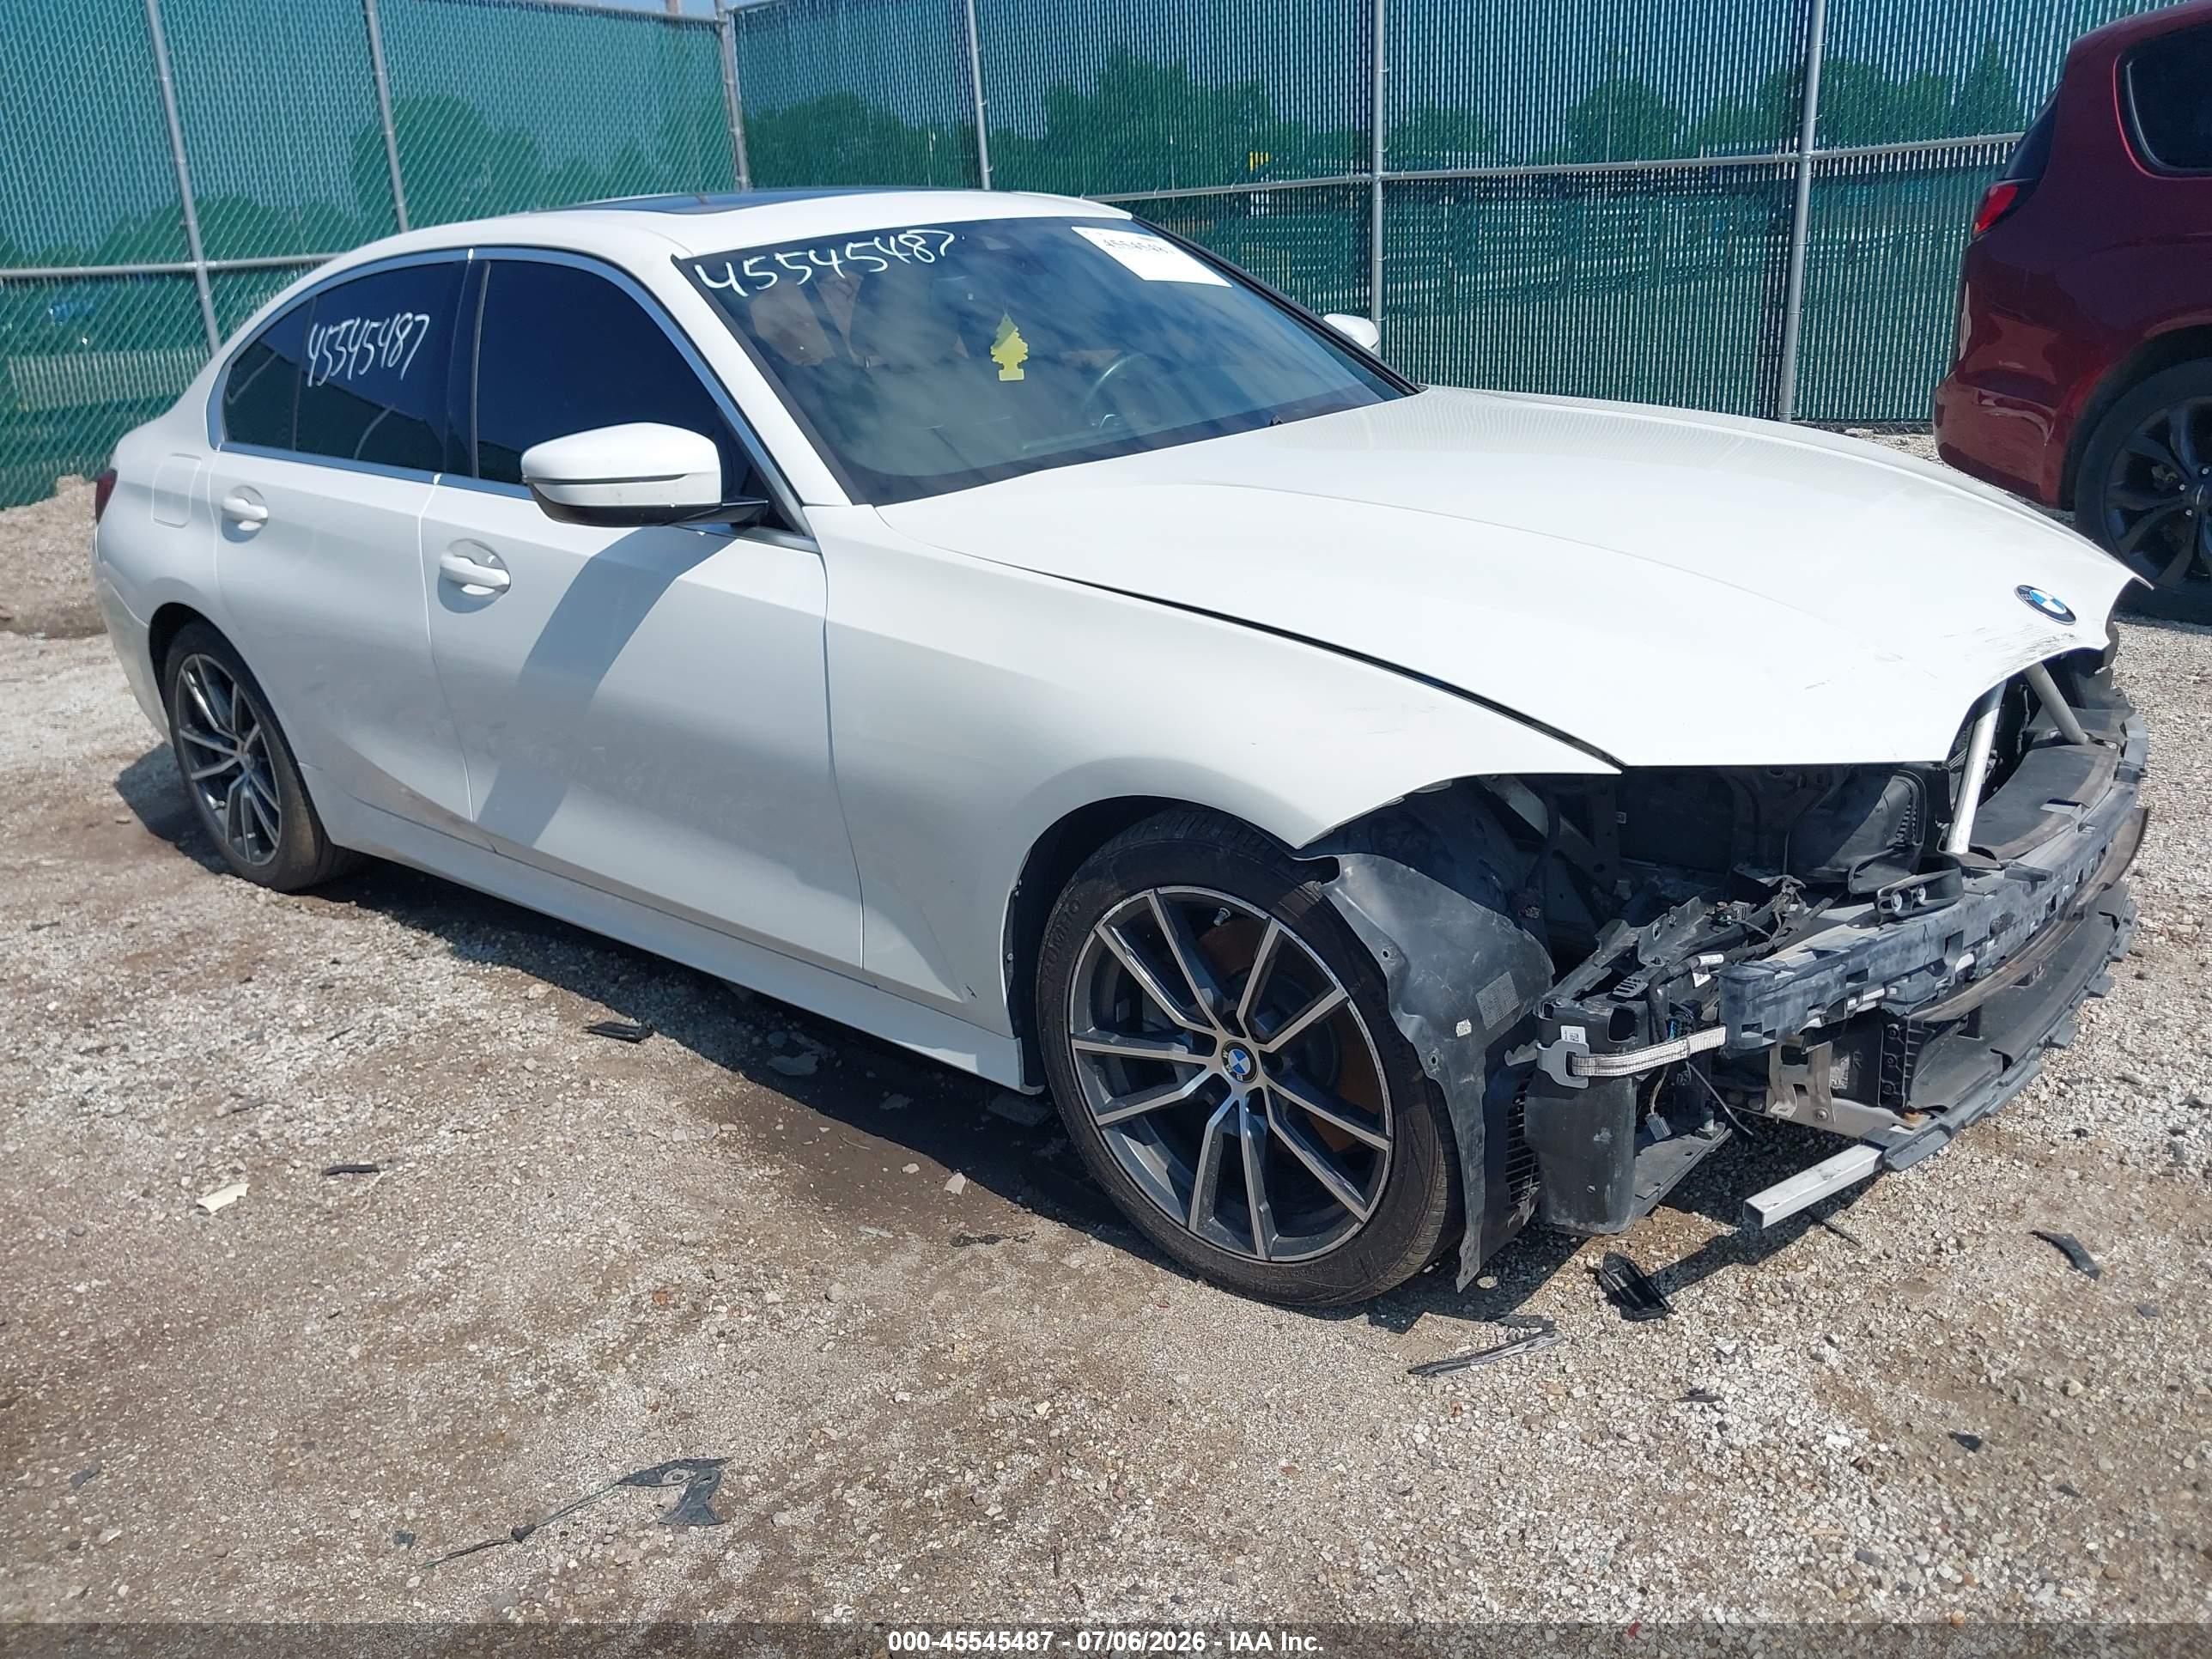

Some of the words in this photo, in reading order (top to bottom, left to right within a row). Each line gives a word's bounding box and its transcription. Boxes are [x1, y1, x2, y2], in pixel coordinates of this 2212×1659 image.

[694, 228, 956, 297] 45545487
[307, 311, 430, 387] 45545487
[1222, 1049, 1244, 1082] BMW
